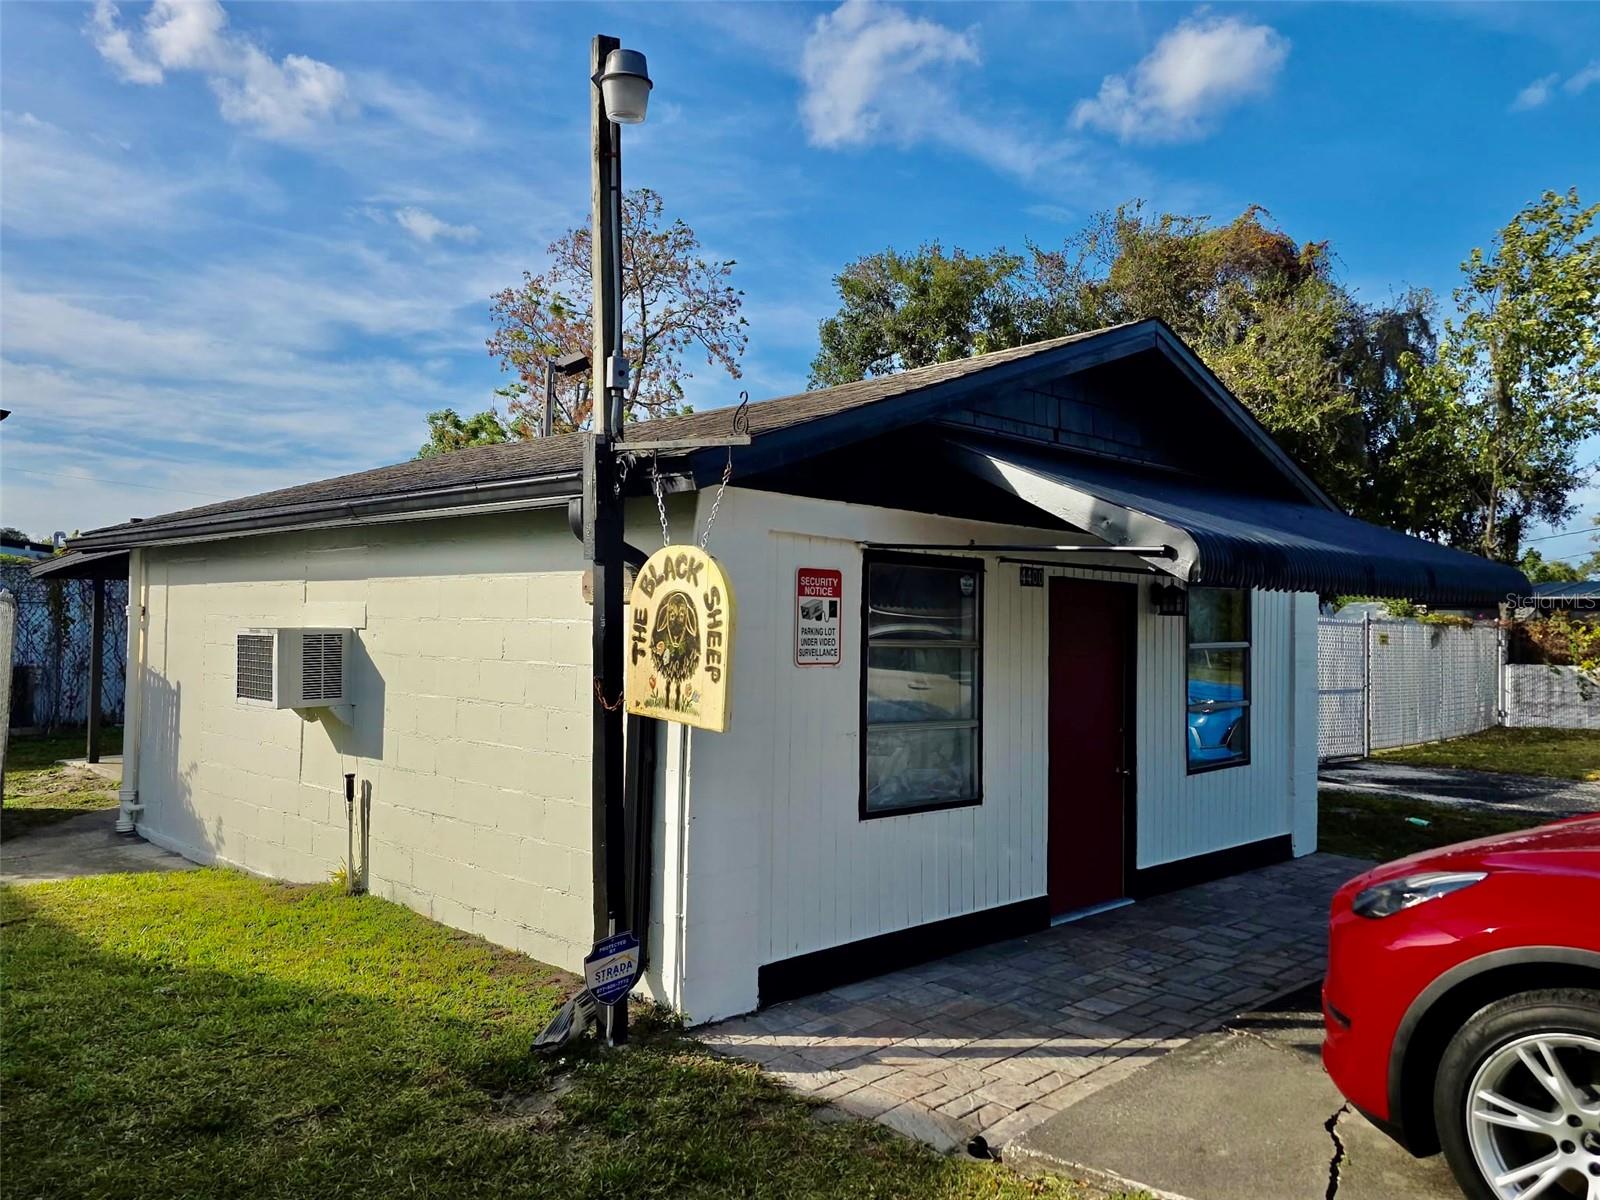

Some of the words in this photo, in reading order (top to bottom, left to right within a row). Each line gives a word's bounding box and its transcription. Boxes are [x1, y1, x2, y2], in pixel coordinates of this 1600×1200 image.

[639, 552, 705, 599] BLACK
[800, 576, 838, 587] SECURITY
[804, 586, 833, 596] NOTICE
[632, 607, 648, 666] THE
[703, 586, 723, 684] SHEEP
[801, 627, 824, 636] PARKING
[824, 628, 836, 636] LOT
[801, 638, 818, 646] UNDER
[819, 638, 836, 646] VIDEO
[799, 648, 838, 657] SURVEILLANCE
[595, 961, 632, 981] STRADA
